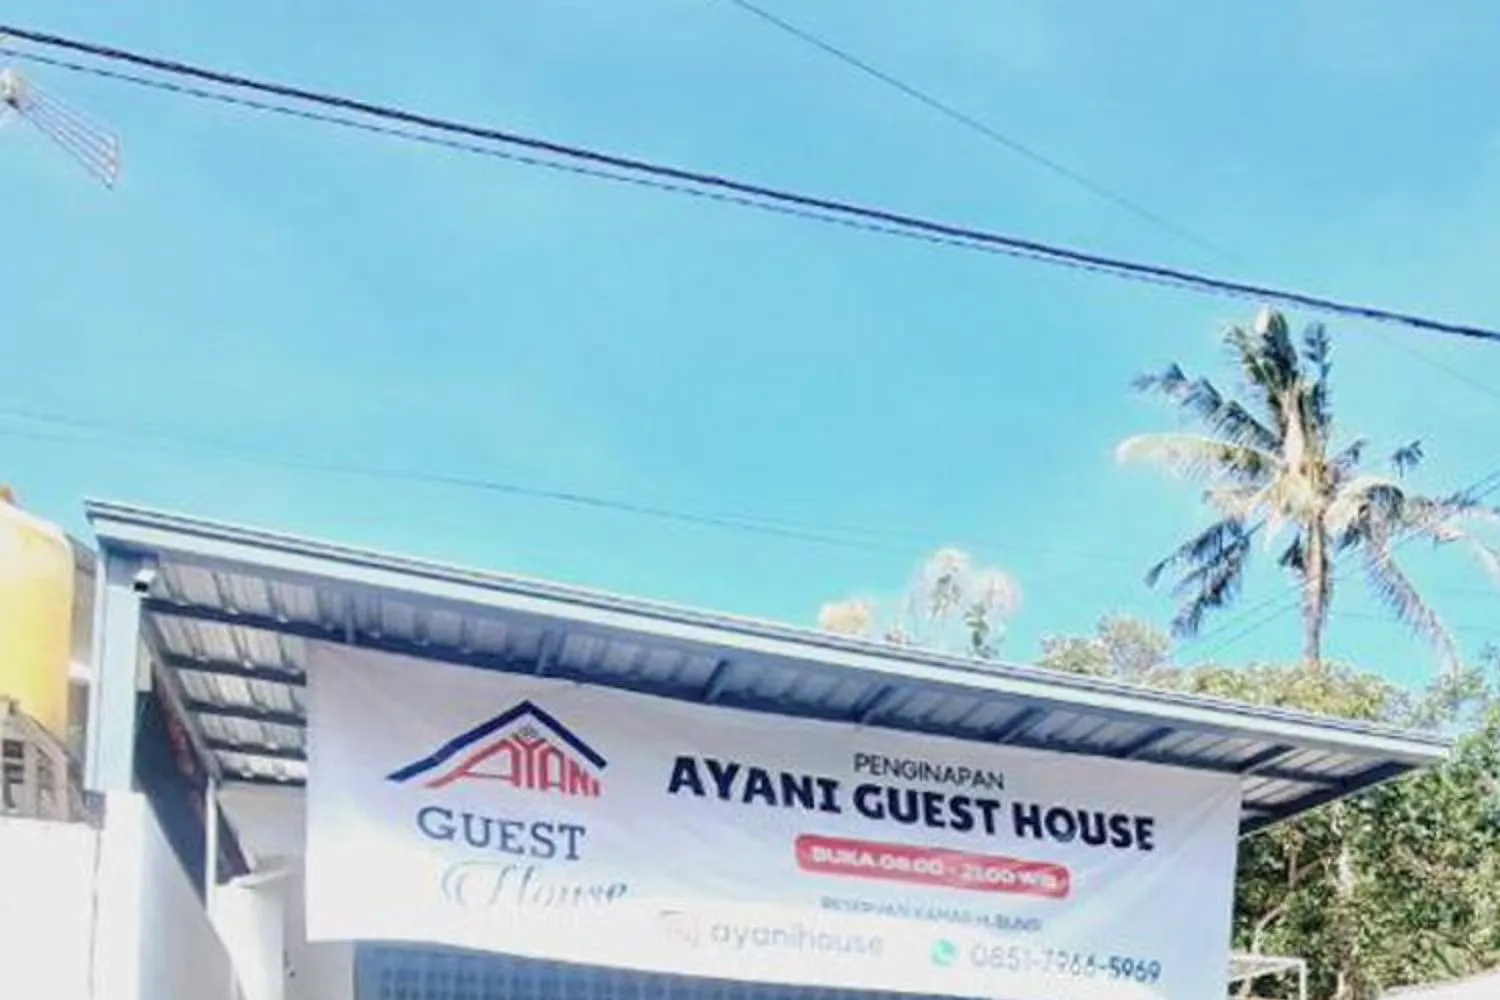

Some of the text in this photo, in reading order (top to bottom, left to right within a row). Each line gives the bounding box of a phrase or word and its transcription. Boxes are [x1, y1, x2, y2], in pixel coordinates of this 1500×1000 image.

[424, 734, 602, 798] AYANI
[853, 752, 1005, 791] PENGINAPAN
[668, 755, 1156, 852] AYANI GUEST HOUSE
[417, 806, 586, 861] GUEST
[812, 845, 876, 869] BUKA
